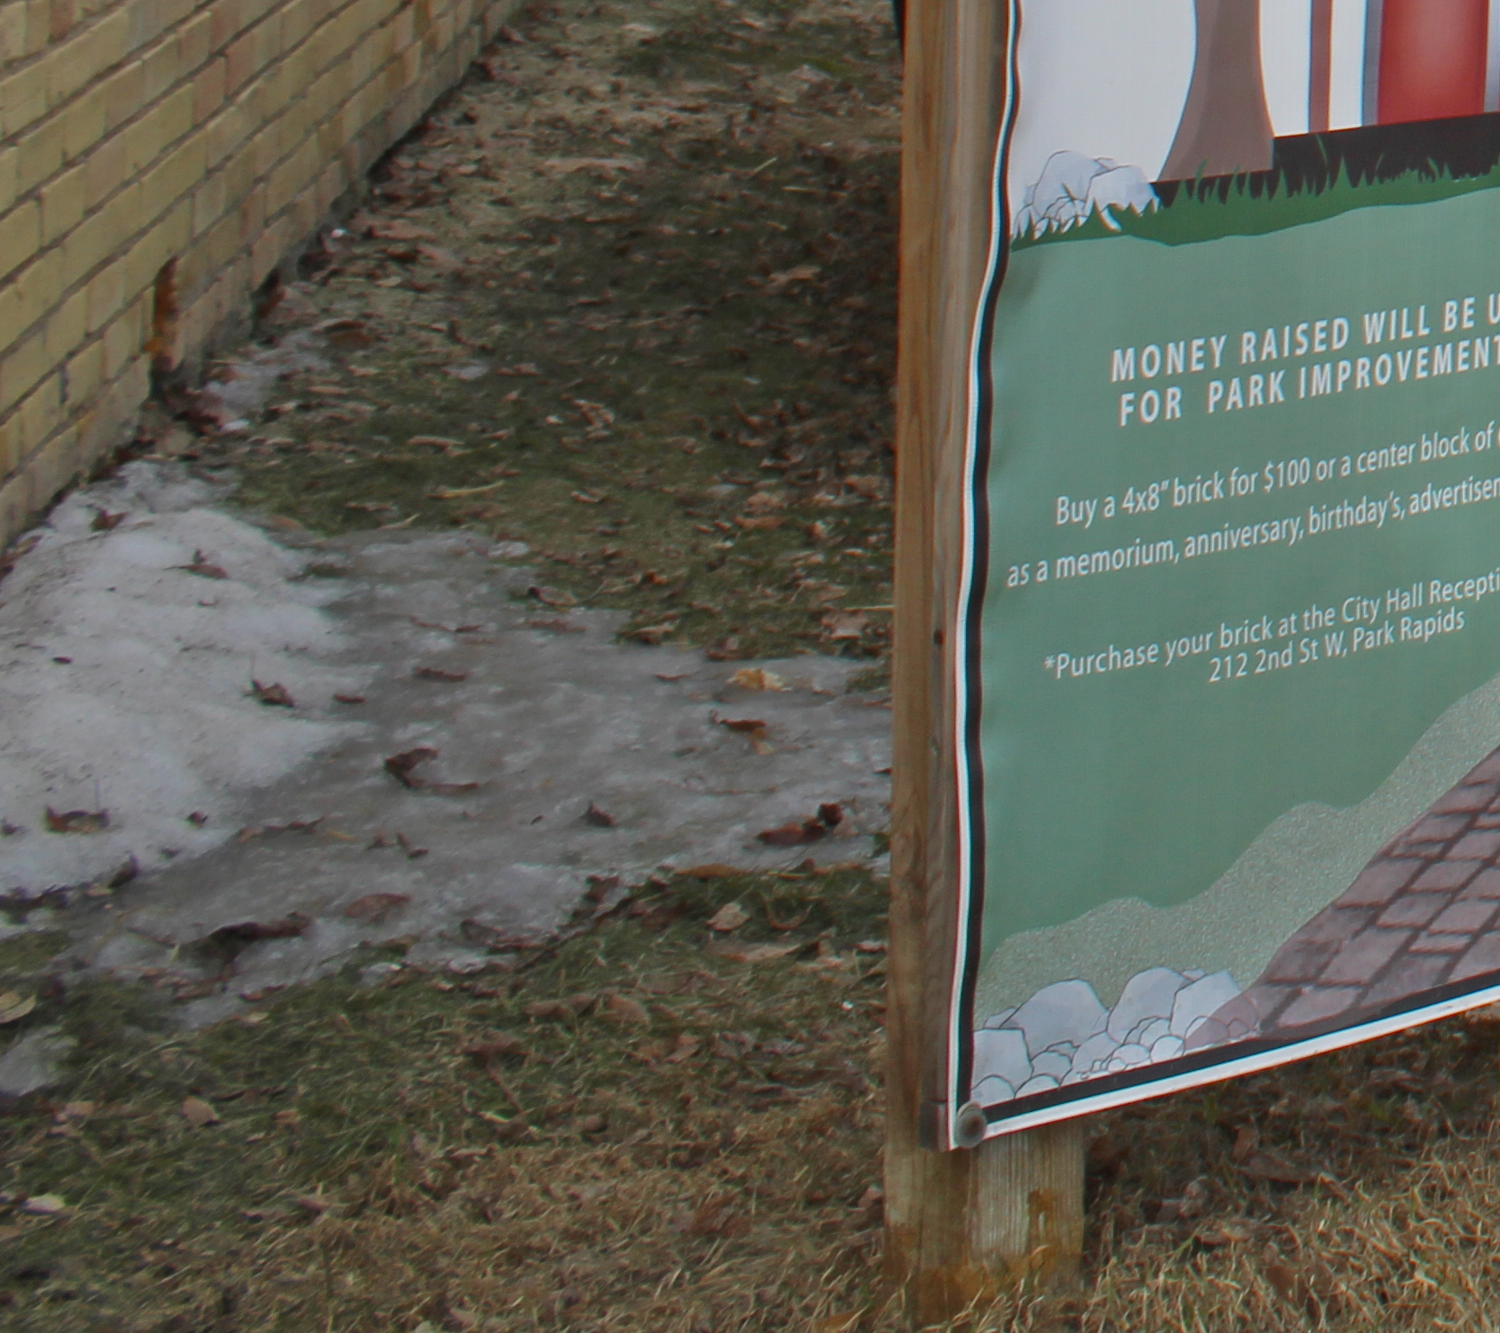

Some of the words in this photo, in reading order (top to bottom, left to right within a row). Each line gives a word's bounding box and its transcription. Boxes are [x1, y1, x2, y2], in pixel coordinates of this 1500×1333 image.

[1110, 334, 1227, 383] MONEY
[1240, 317, 1350, 366] RAISED
[1362, 306, 1432, 349] WILL
[1442, 298, 1477, 335] BE
[1119, 386, 1182, 426] FOR
[1207, 369, 1287, 414] PARK
[1056, 495, 1098, 529] Buy
[1104, 494, 1115, 519] a
[1172, 470, 1225, 508] brick
[1229, 466, 1259, 497] for
[1263, 457, 1310, 493] $100
[1315, 458, 1337, 482] or
[1340, 455, 1352, 477] a
[1357, 441, 1416, 474] center
[1420, 426, 1470, 462] block
[1474, 420, 1496, 452] of
[1008, 562, 1030, 588] as
[1036, 559, 1049, 583] a
[1055, 537, 1181, 580] memorium,
[1185, 515, 1305, 559] anniversary,
[1165, 631, 1214, 667] your
[1219, 614, 1273, 649] brick
[1278, 612, 1298, 638] at
[1303, 603, 1335, 632] the
[1342, 595, 1382, 625] City
[1386, 581, 1424, 614] Hall
[1208, 651, 1249, 683] 212
[1254, 640, 1293, 675] 2nd
[1299, 637, 1319, 664] St
[1324, 631, 1347, 658] W,
[1352, 620, 1395, 652] Park
[1400, 606, 1466, 643] Rapids
